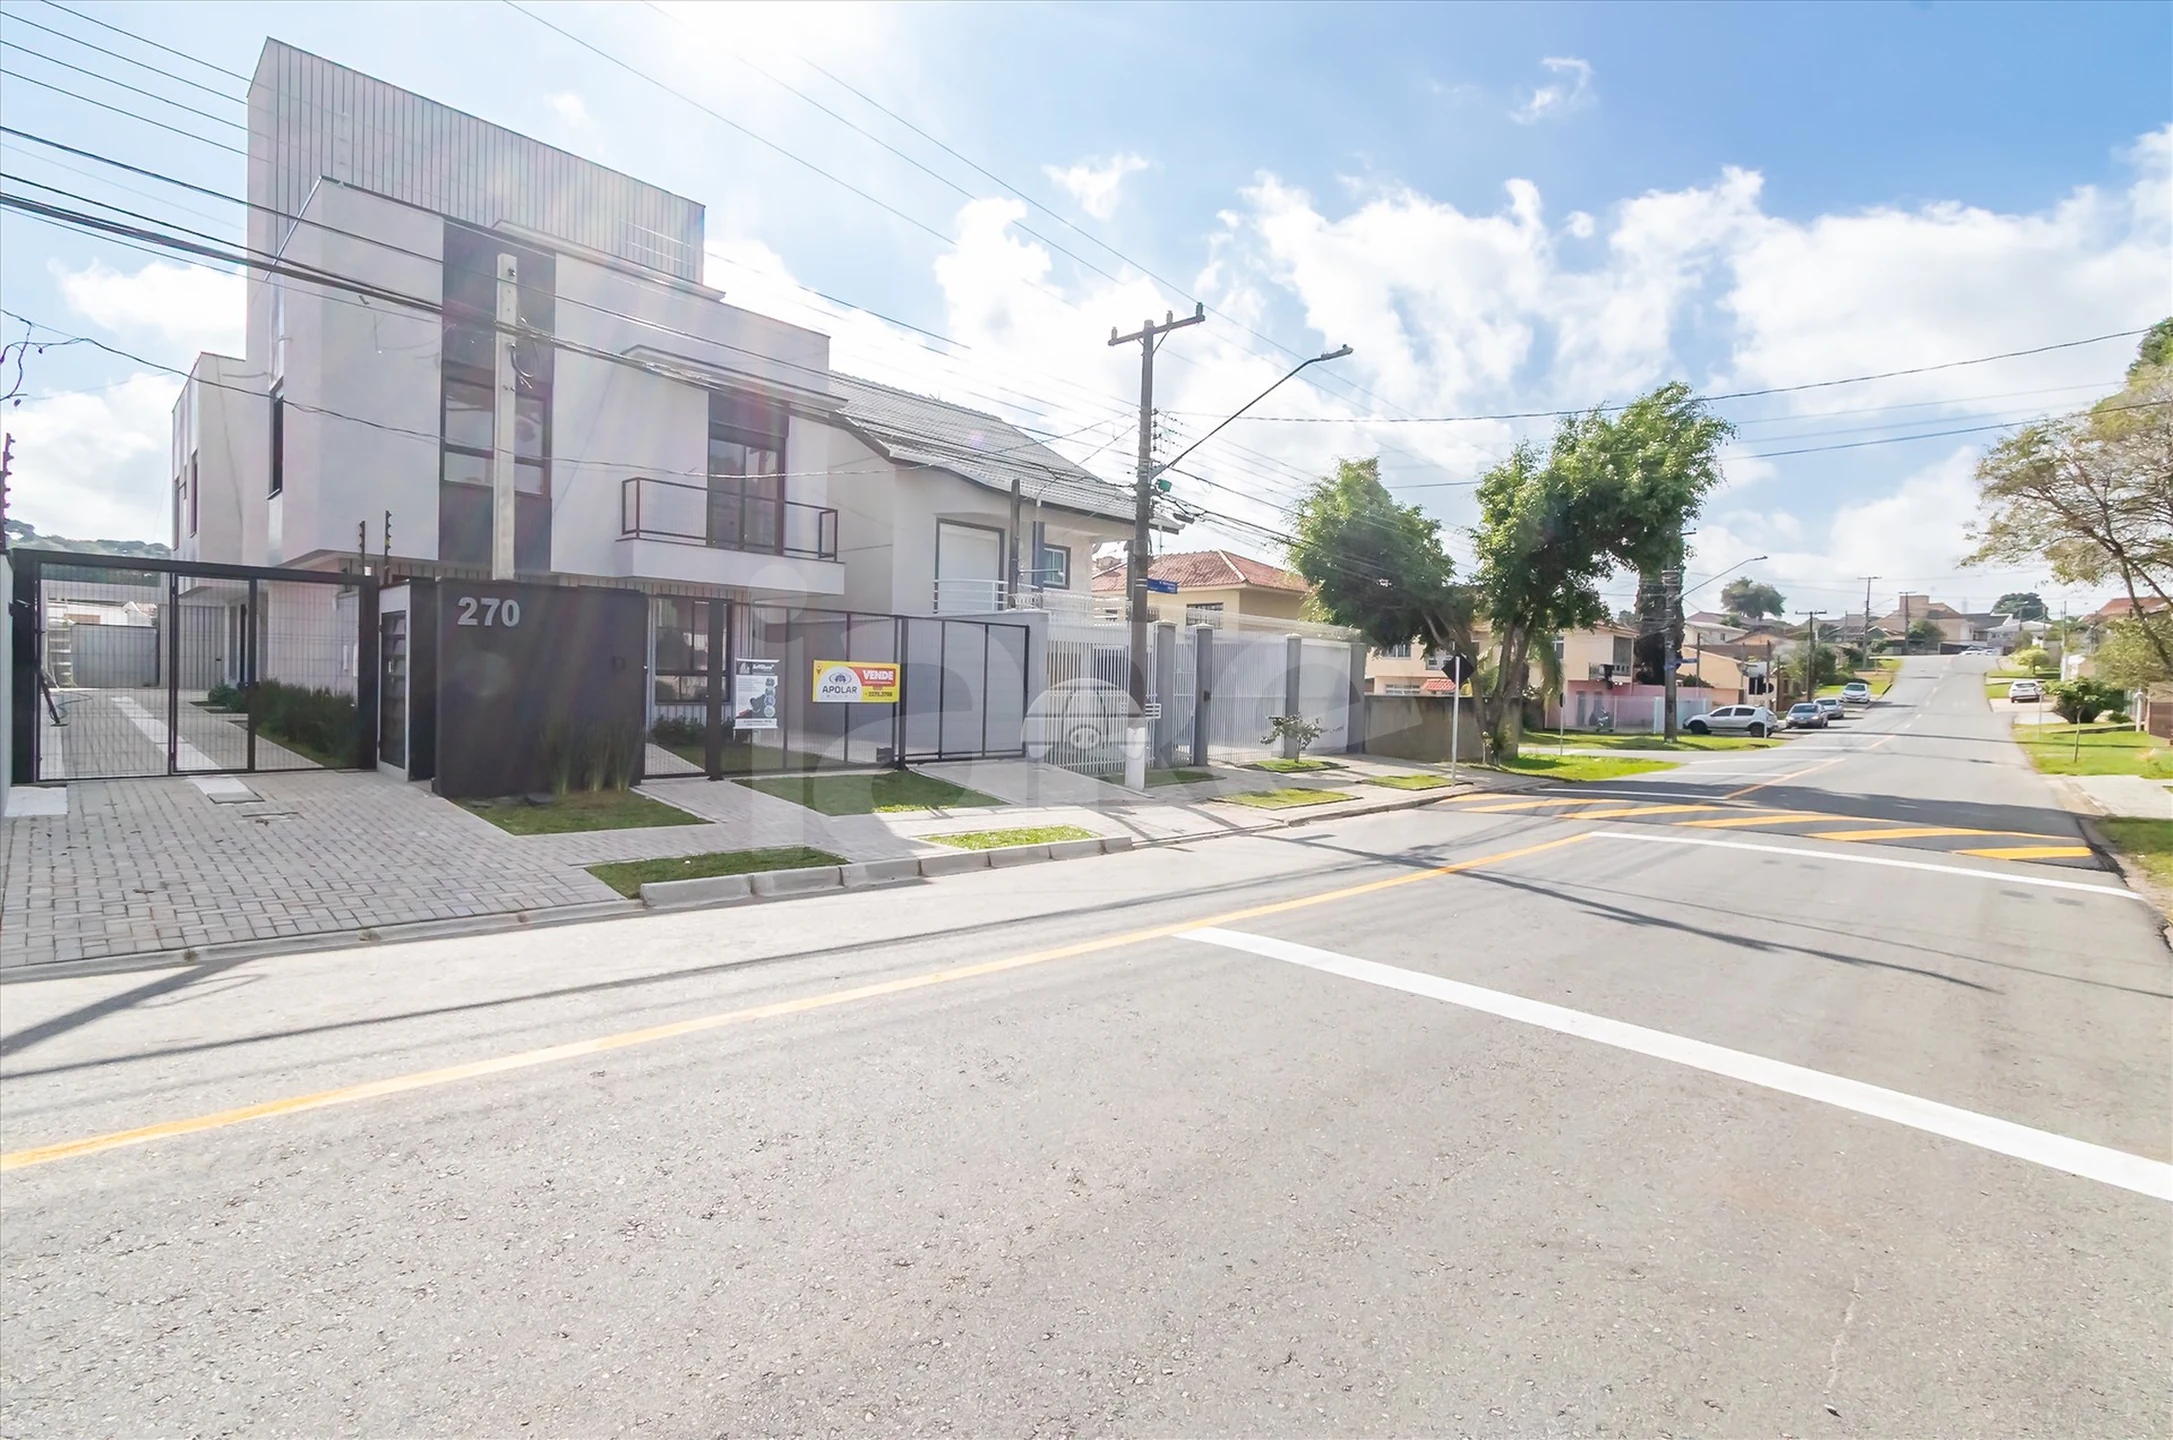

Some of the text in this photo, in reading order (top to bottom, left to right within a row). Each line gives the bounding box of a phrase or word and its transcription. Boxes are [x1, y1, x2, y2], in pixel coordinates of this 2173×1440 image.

[457, 596, 520, 627] 270
[862, 669, 894, 680] VENDE
[822, 685, 858, 694] APOLAR
